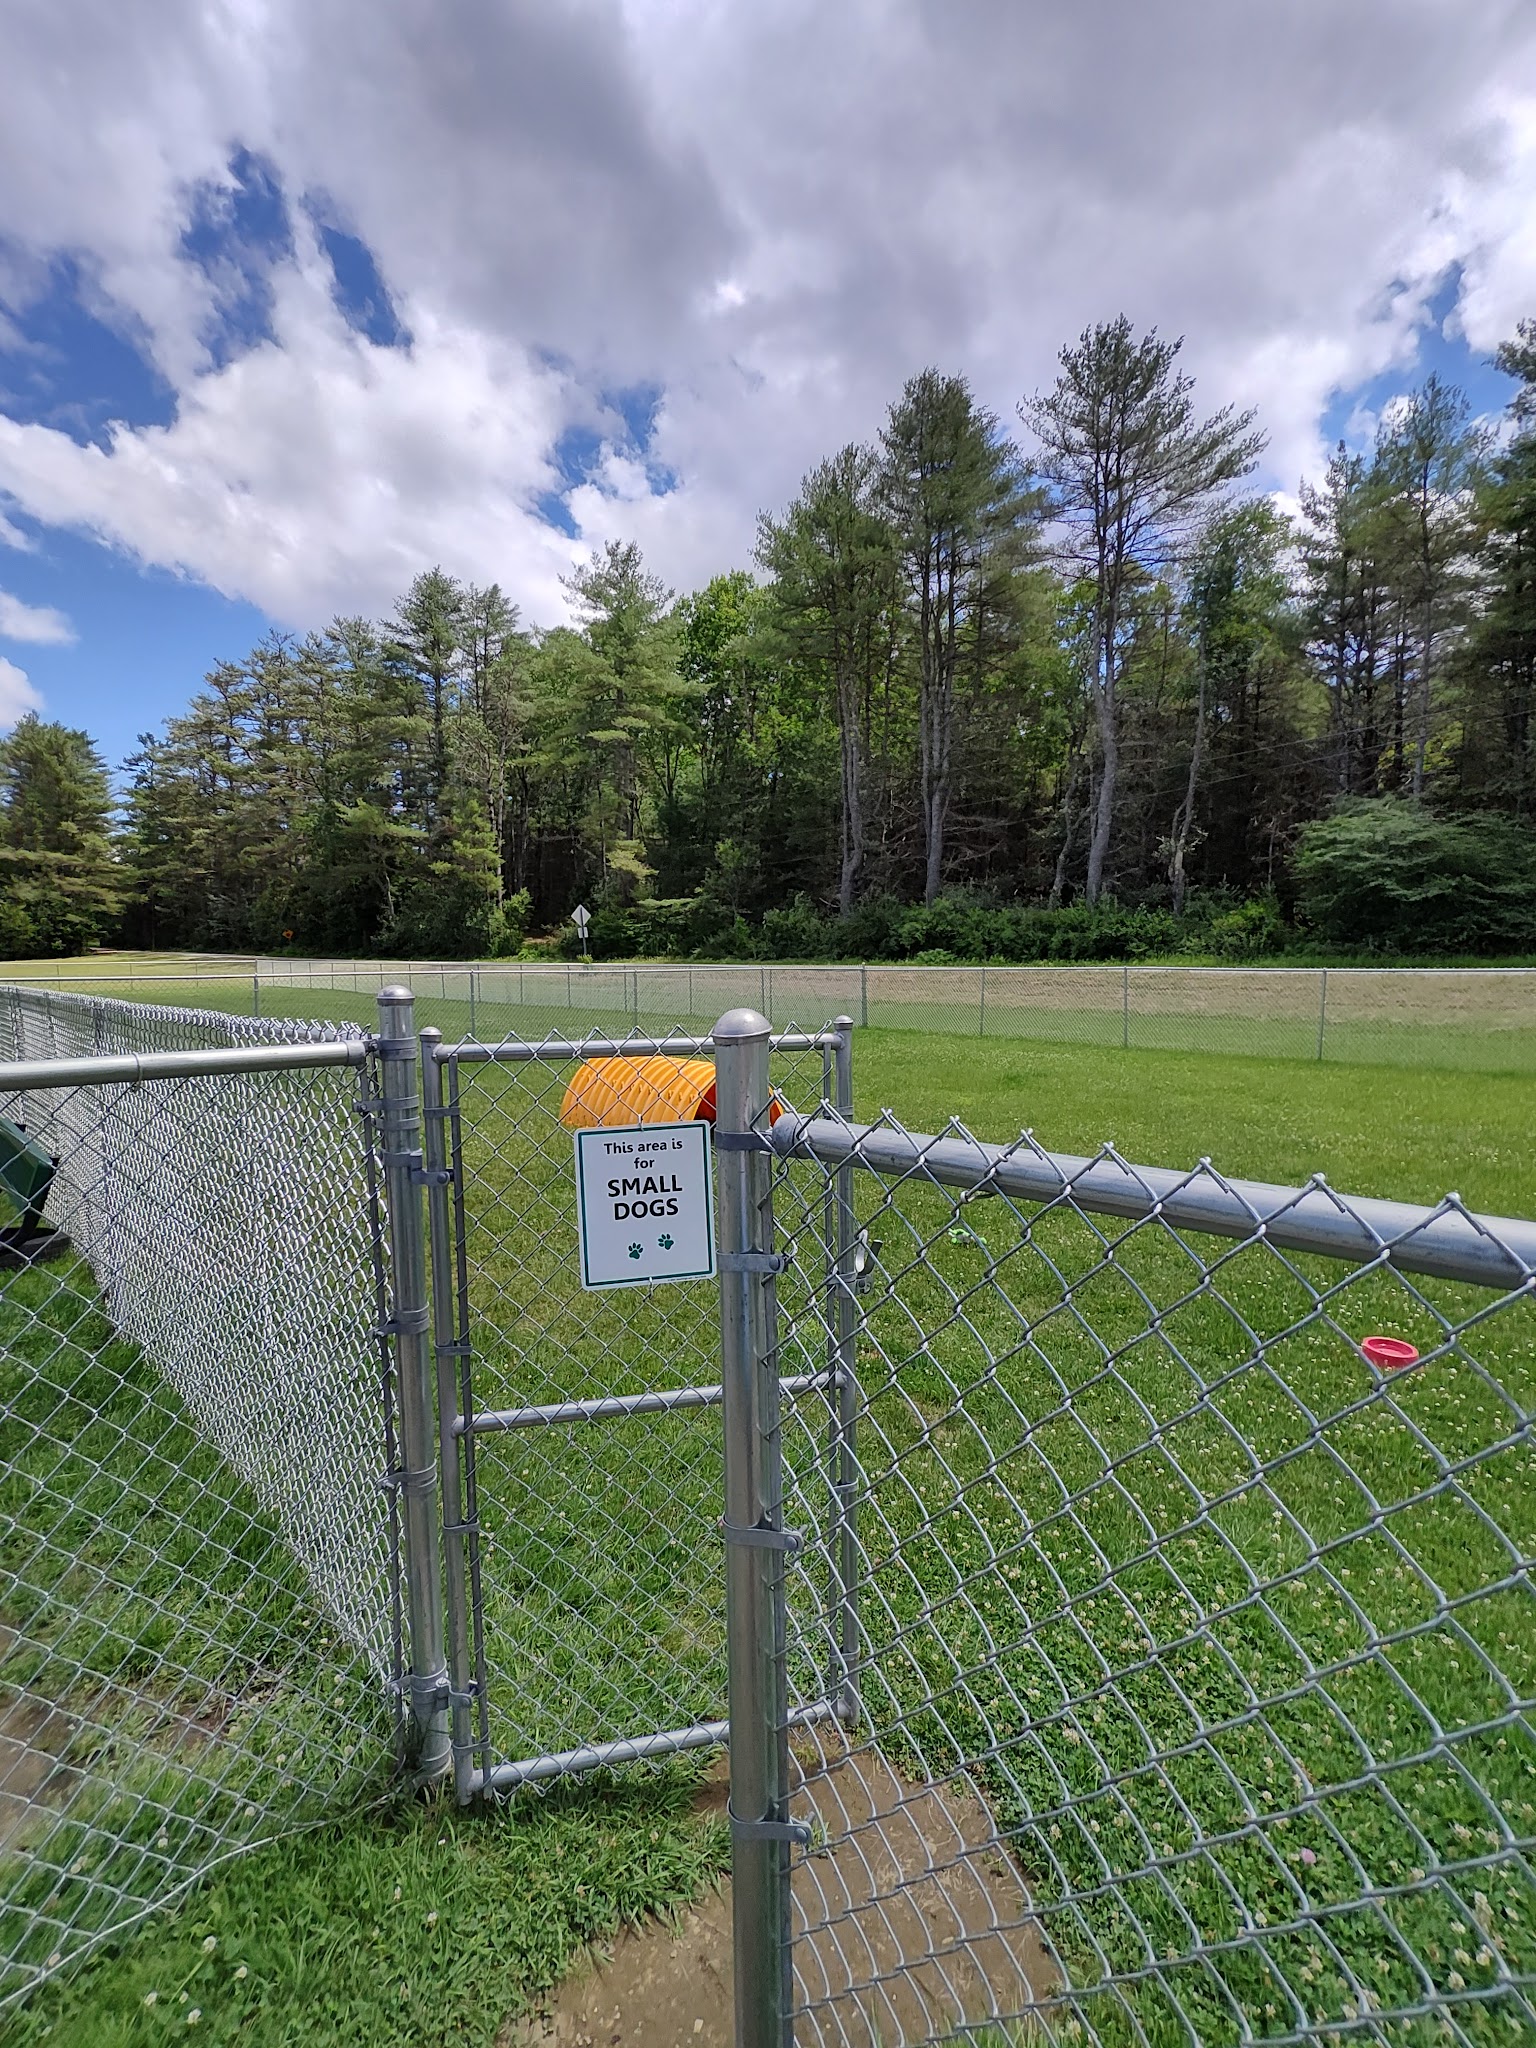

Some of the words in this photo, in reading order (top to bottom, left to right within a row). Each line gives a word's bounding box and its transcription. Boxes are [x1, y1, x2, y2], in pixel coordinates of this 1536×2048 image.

[604, 1141, 634, 1154] This
[638, 1142, 667, 1152] area
[671, 1138, 683, 1149] is
[634, 1157, 655, 1169] for
[607, 1174, 683, 1198] SMALL
[614, 1198, 679, 1220] DOGS
